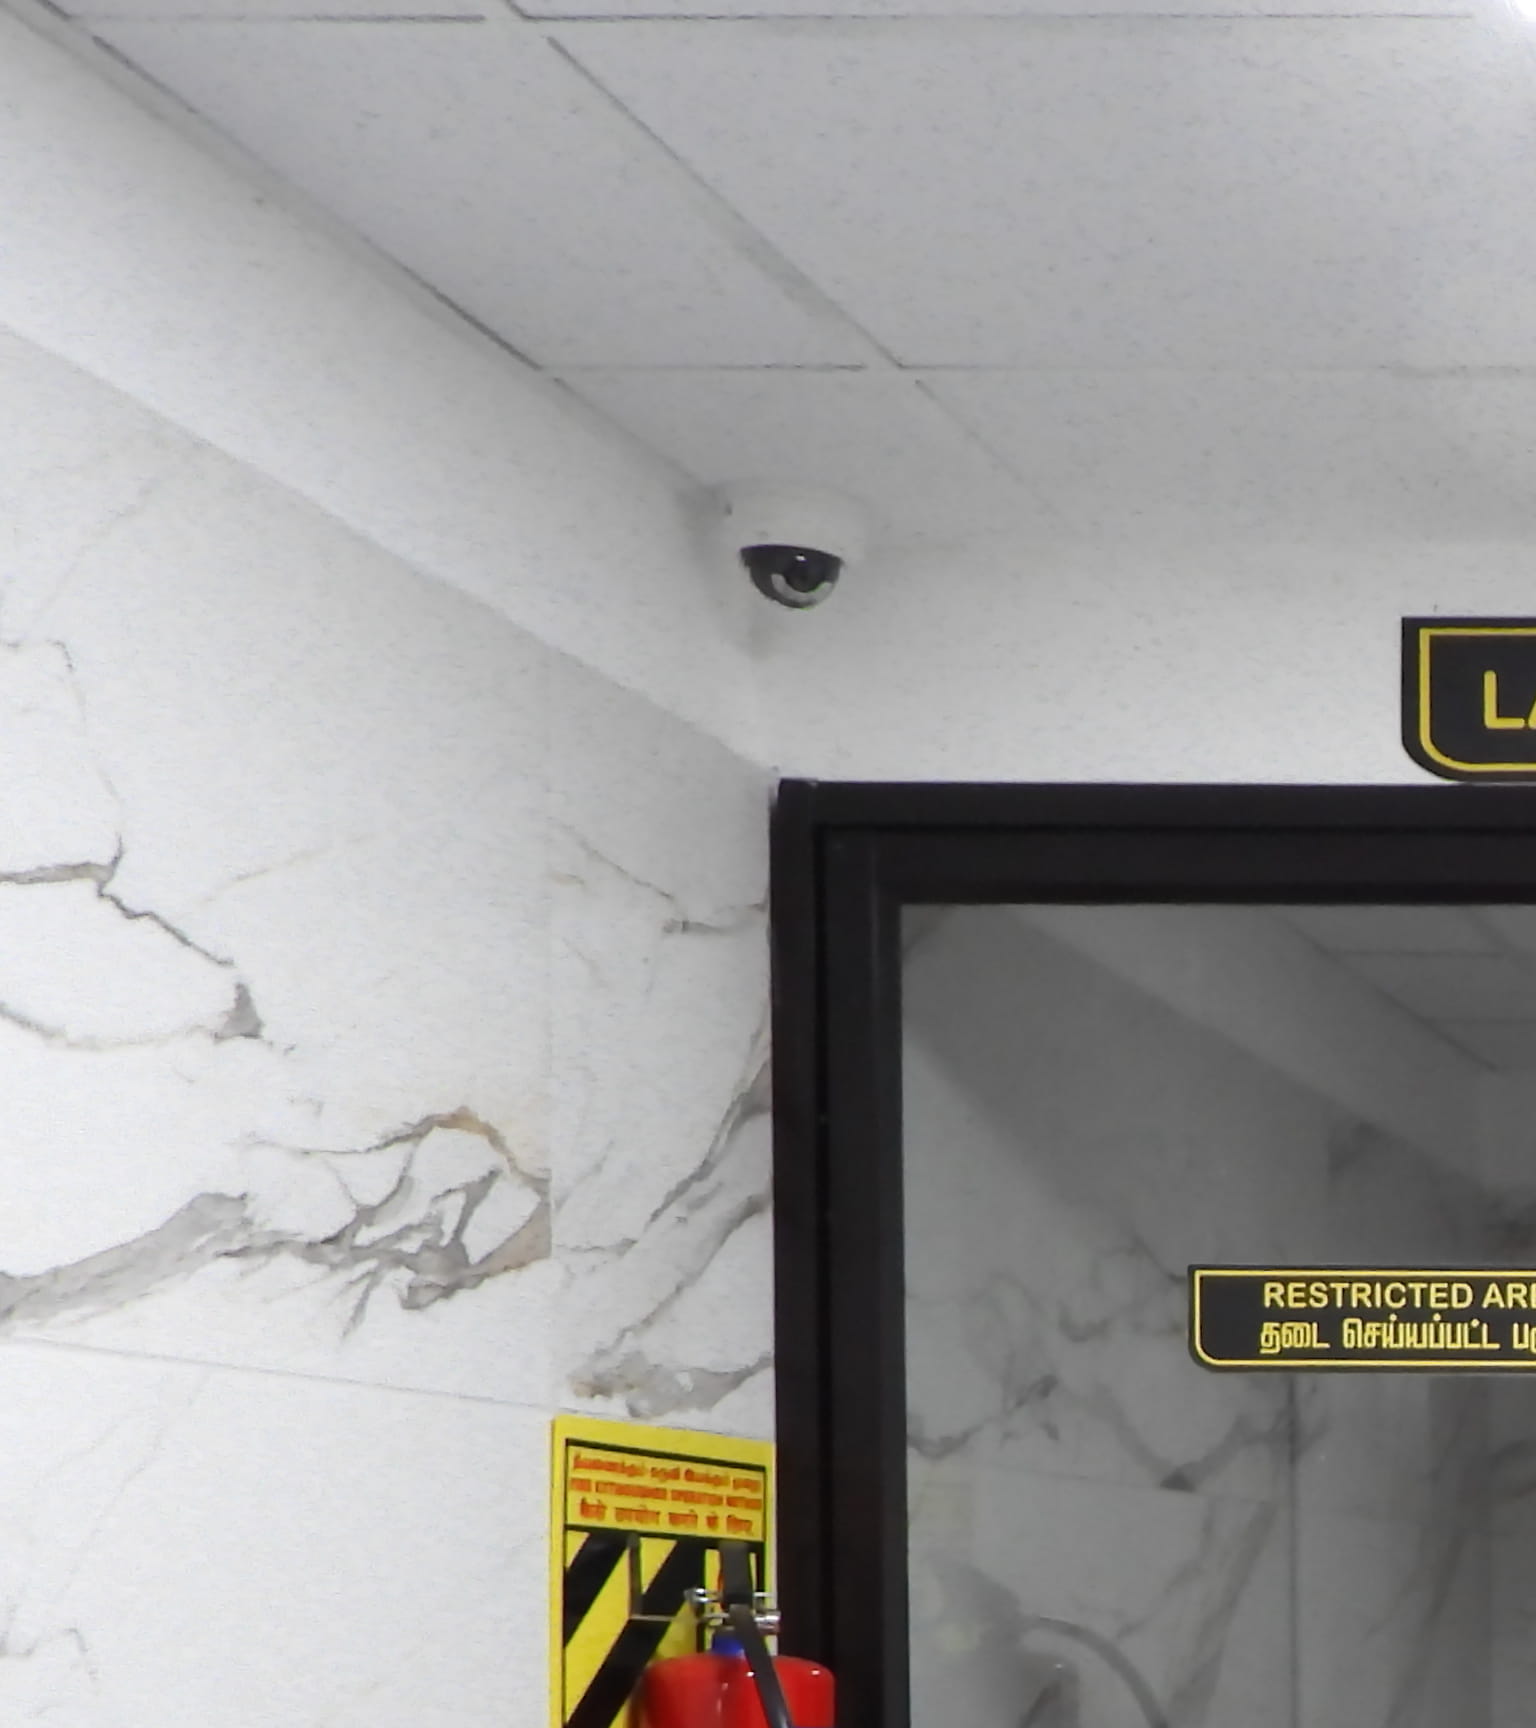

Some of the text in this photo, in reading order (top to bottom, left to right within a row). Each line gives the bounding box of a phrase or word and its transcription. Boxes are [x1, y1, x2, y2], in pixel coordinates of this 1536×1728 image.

[1262, 1281, 1473, 1310] RESTRICTED
[1259, 1318, 1331, 1354] தடை
[1342, 1314, 1500, 1350] செய்யப்பட்ட
